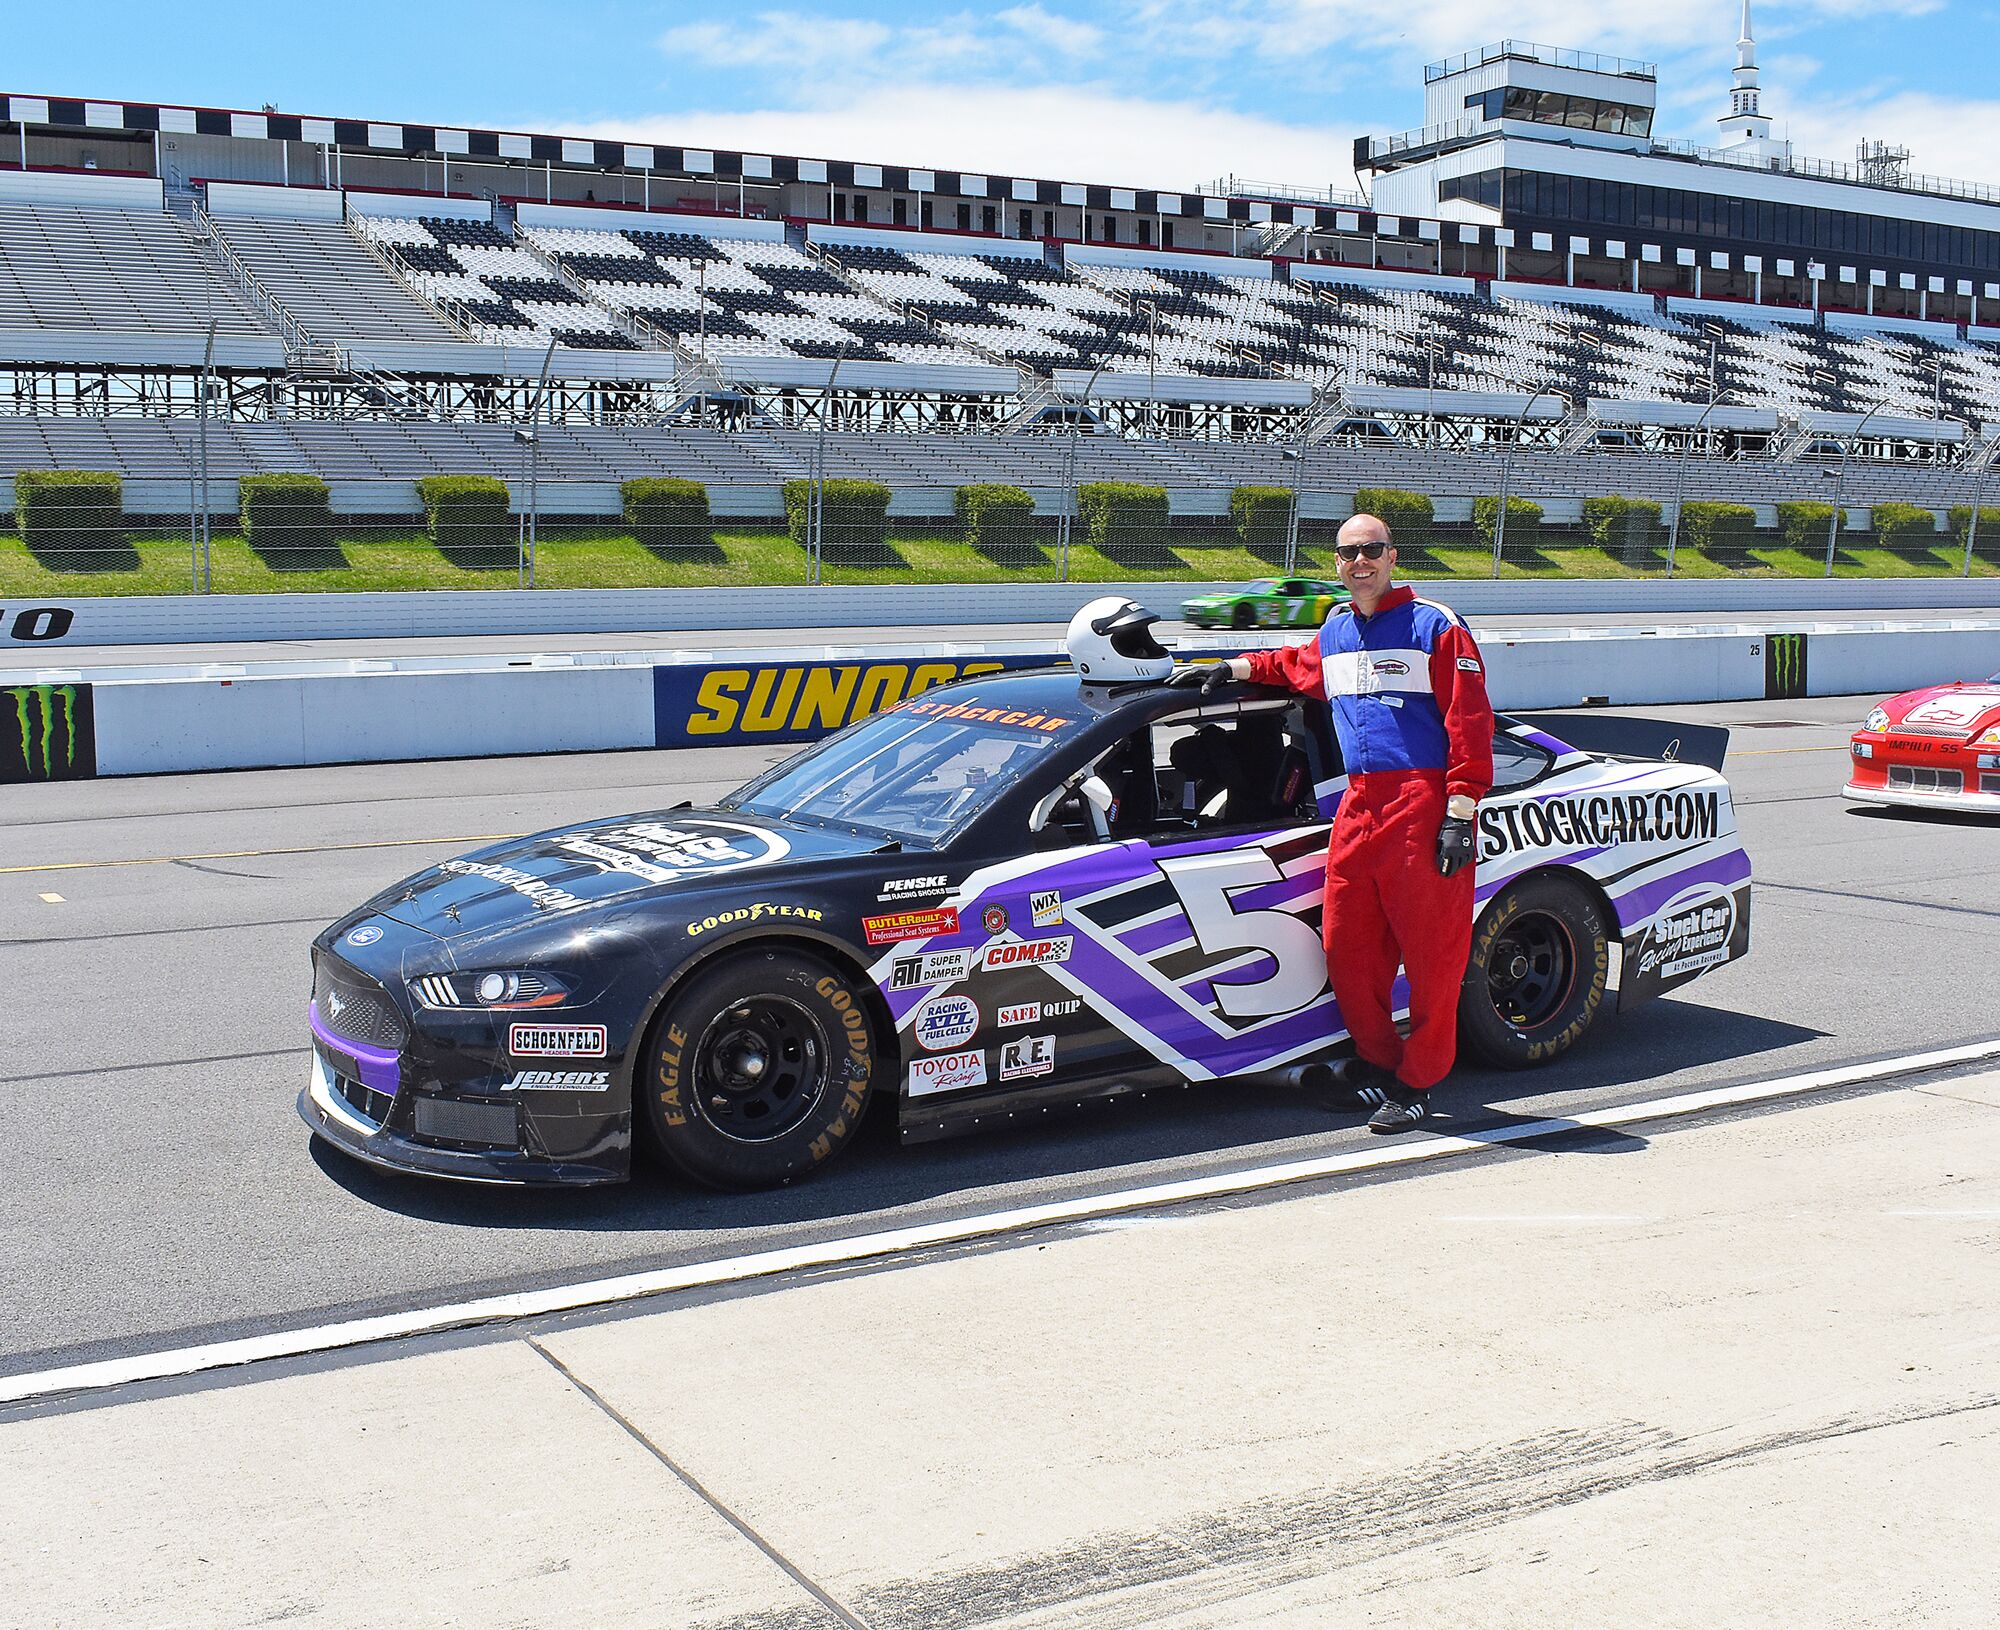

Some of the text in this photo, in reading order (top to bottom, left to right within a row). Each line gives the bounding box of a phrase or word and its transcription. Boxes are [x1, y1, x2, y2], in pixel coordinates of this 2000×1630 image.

[1285, 600, 1305, 621] 7
[1750, 645, 1760, 656] 25
[687, 662, 1004, 735] SUNOC
[1888, 740, 1959, 754] IMPALA SS
[1476, 791, 1717, 857] STOCKCAR.COM
[883, 875, 948, 892] PENSKE
[891, 891, 917, 900] RACING
[918, 887, 945, 897] SHOCKS
[1032, 892, 1058, 912] WIX
[872, 926, 939, 941] Professional Seat Systems
[1153, 845, 1329, 1018] 5
[1473, 894, 1518, 969] EAGLE
[1654, 907, 1730, 943] Stock Car
[930, 955, 961, 966] SUPER
[986, 941, 1051, 965] COMP
[1031, 953, 1061, 963] CAMS
[1637, 929, 1724, 978] Racing Experience
[892, 957, 923, 987] ATI
[924, 967, 963, 980] DAMPER
[928, 1002, 967, 1016] RACING
[1000, 999, 1081, 1024] SAFE QUIP
[516, 1031, 600, 1050] SCHOENFELD
[659, 1023, 688, 1127] EAGLE
[913, 1053, 980, 1077] TOYOTA
[931, 1070, 981, 1089] Racing
